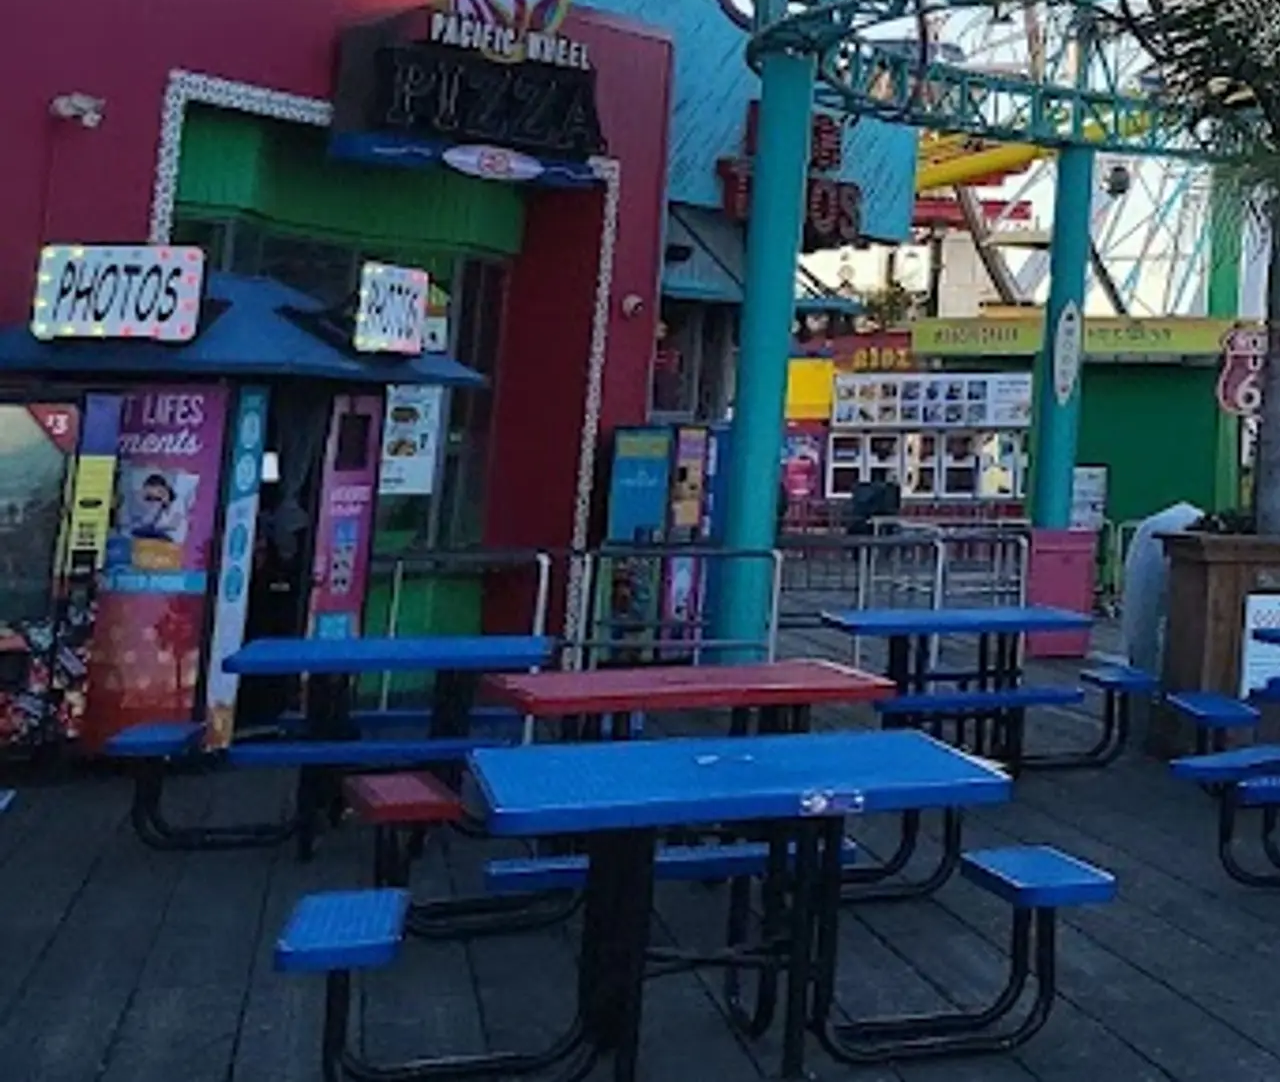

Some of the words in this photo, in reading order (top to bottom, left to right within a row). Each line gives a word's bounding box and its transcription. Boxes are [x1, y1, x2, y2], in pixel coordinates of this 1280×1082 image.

[430, 12, 516, 54] PACIFIC
[527, 31, 591, 70] WHEEL
[386, 63, 594, 149] PIZZA
[52, 260, 182, 323] PHOTOS
[143, 393, 204, 425] LIFES
